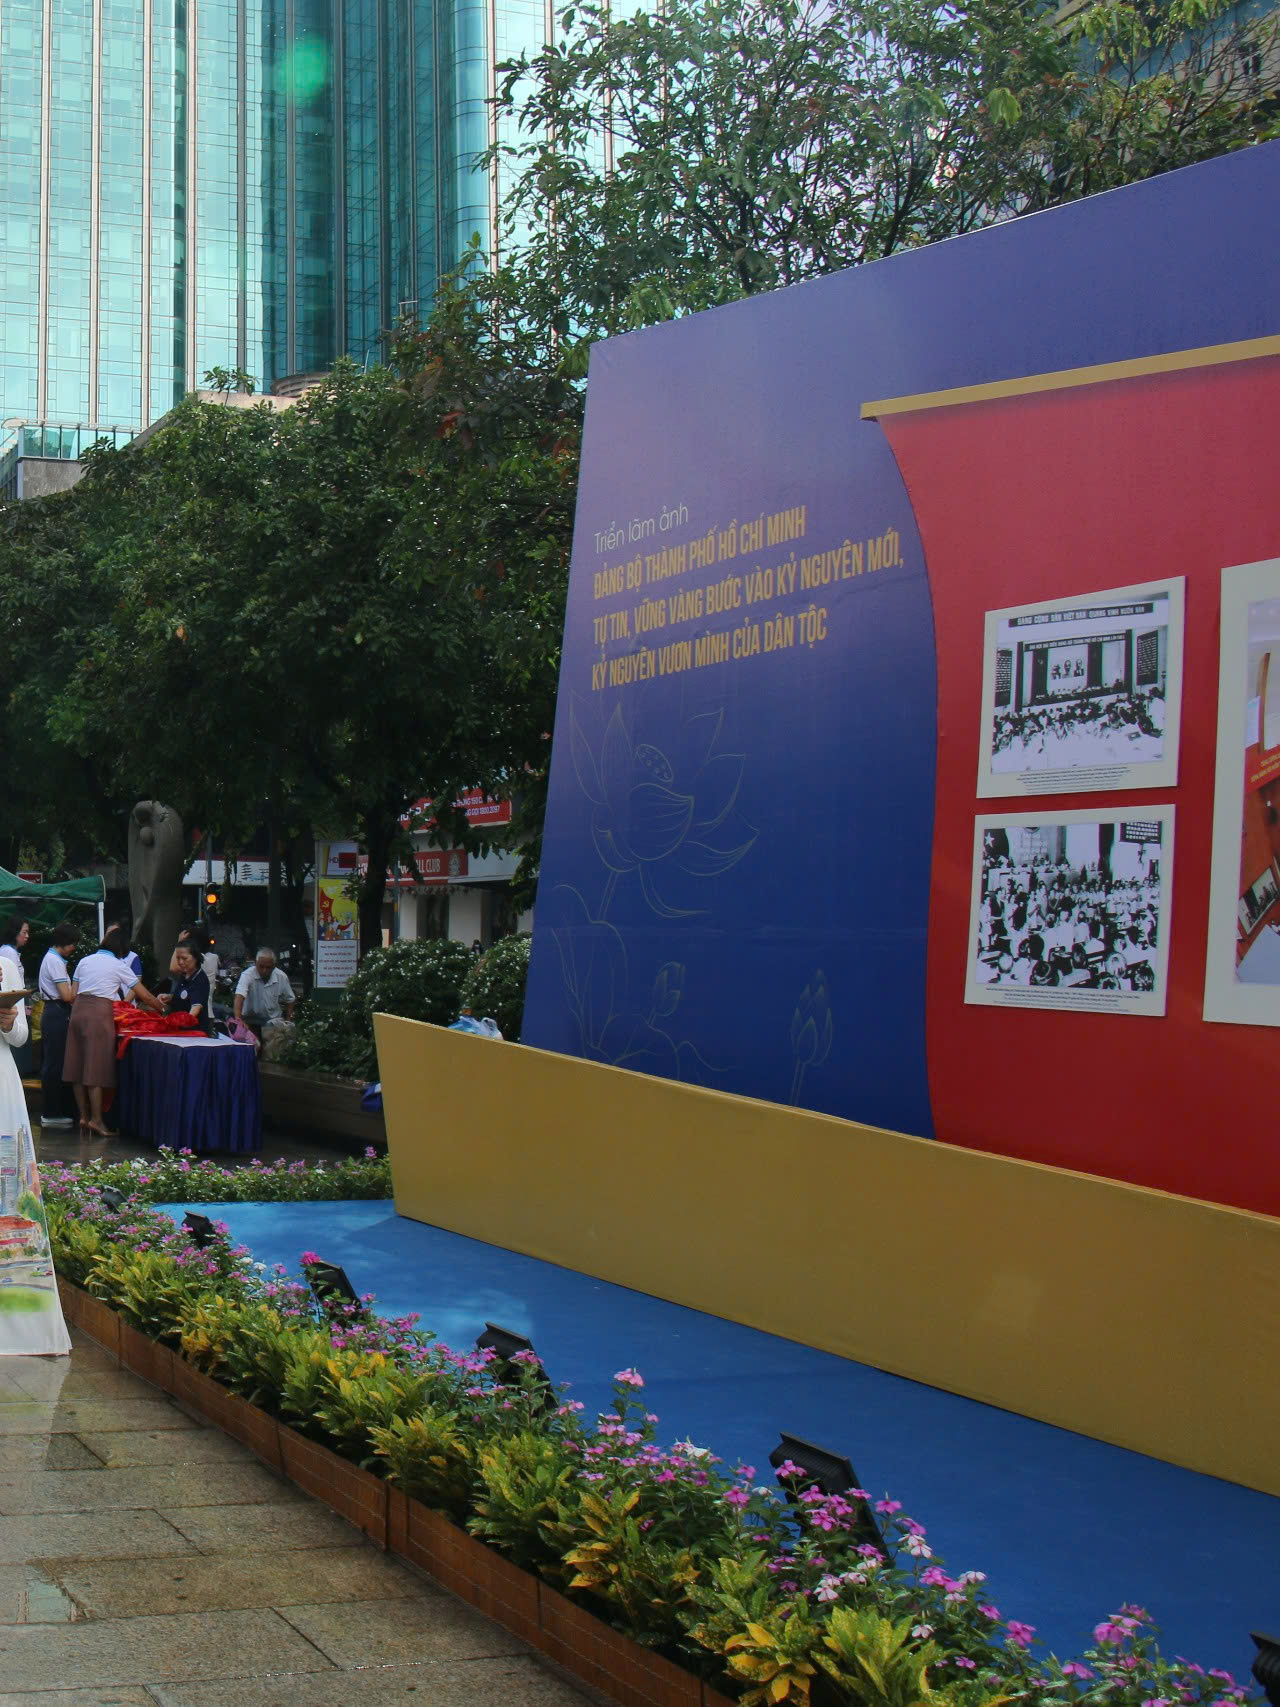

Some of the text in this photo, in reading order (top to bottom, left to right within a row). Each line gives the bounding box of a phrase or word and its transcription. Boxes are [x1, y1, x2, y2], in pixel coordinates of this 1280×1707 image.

[593, 505, 807, 600] ĐẢNG BỘ THÀNH PHỐ HỒ CHÍ MINH
[594, 502, 689, 554] Triển lãm ảnh
[593, 526, 905, 649] TỰ TIN, VỮNG VÀNG BƯỚC VÀO KỶ NGUYÊN MỚI,
[592, 603, 828, 691] KỶ NGUYÊN VƯƠN MÌNH CỦA DÂN TỘC
[426, 858, 440, 873] CLUB
